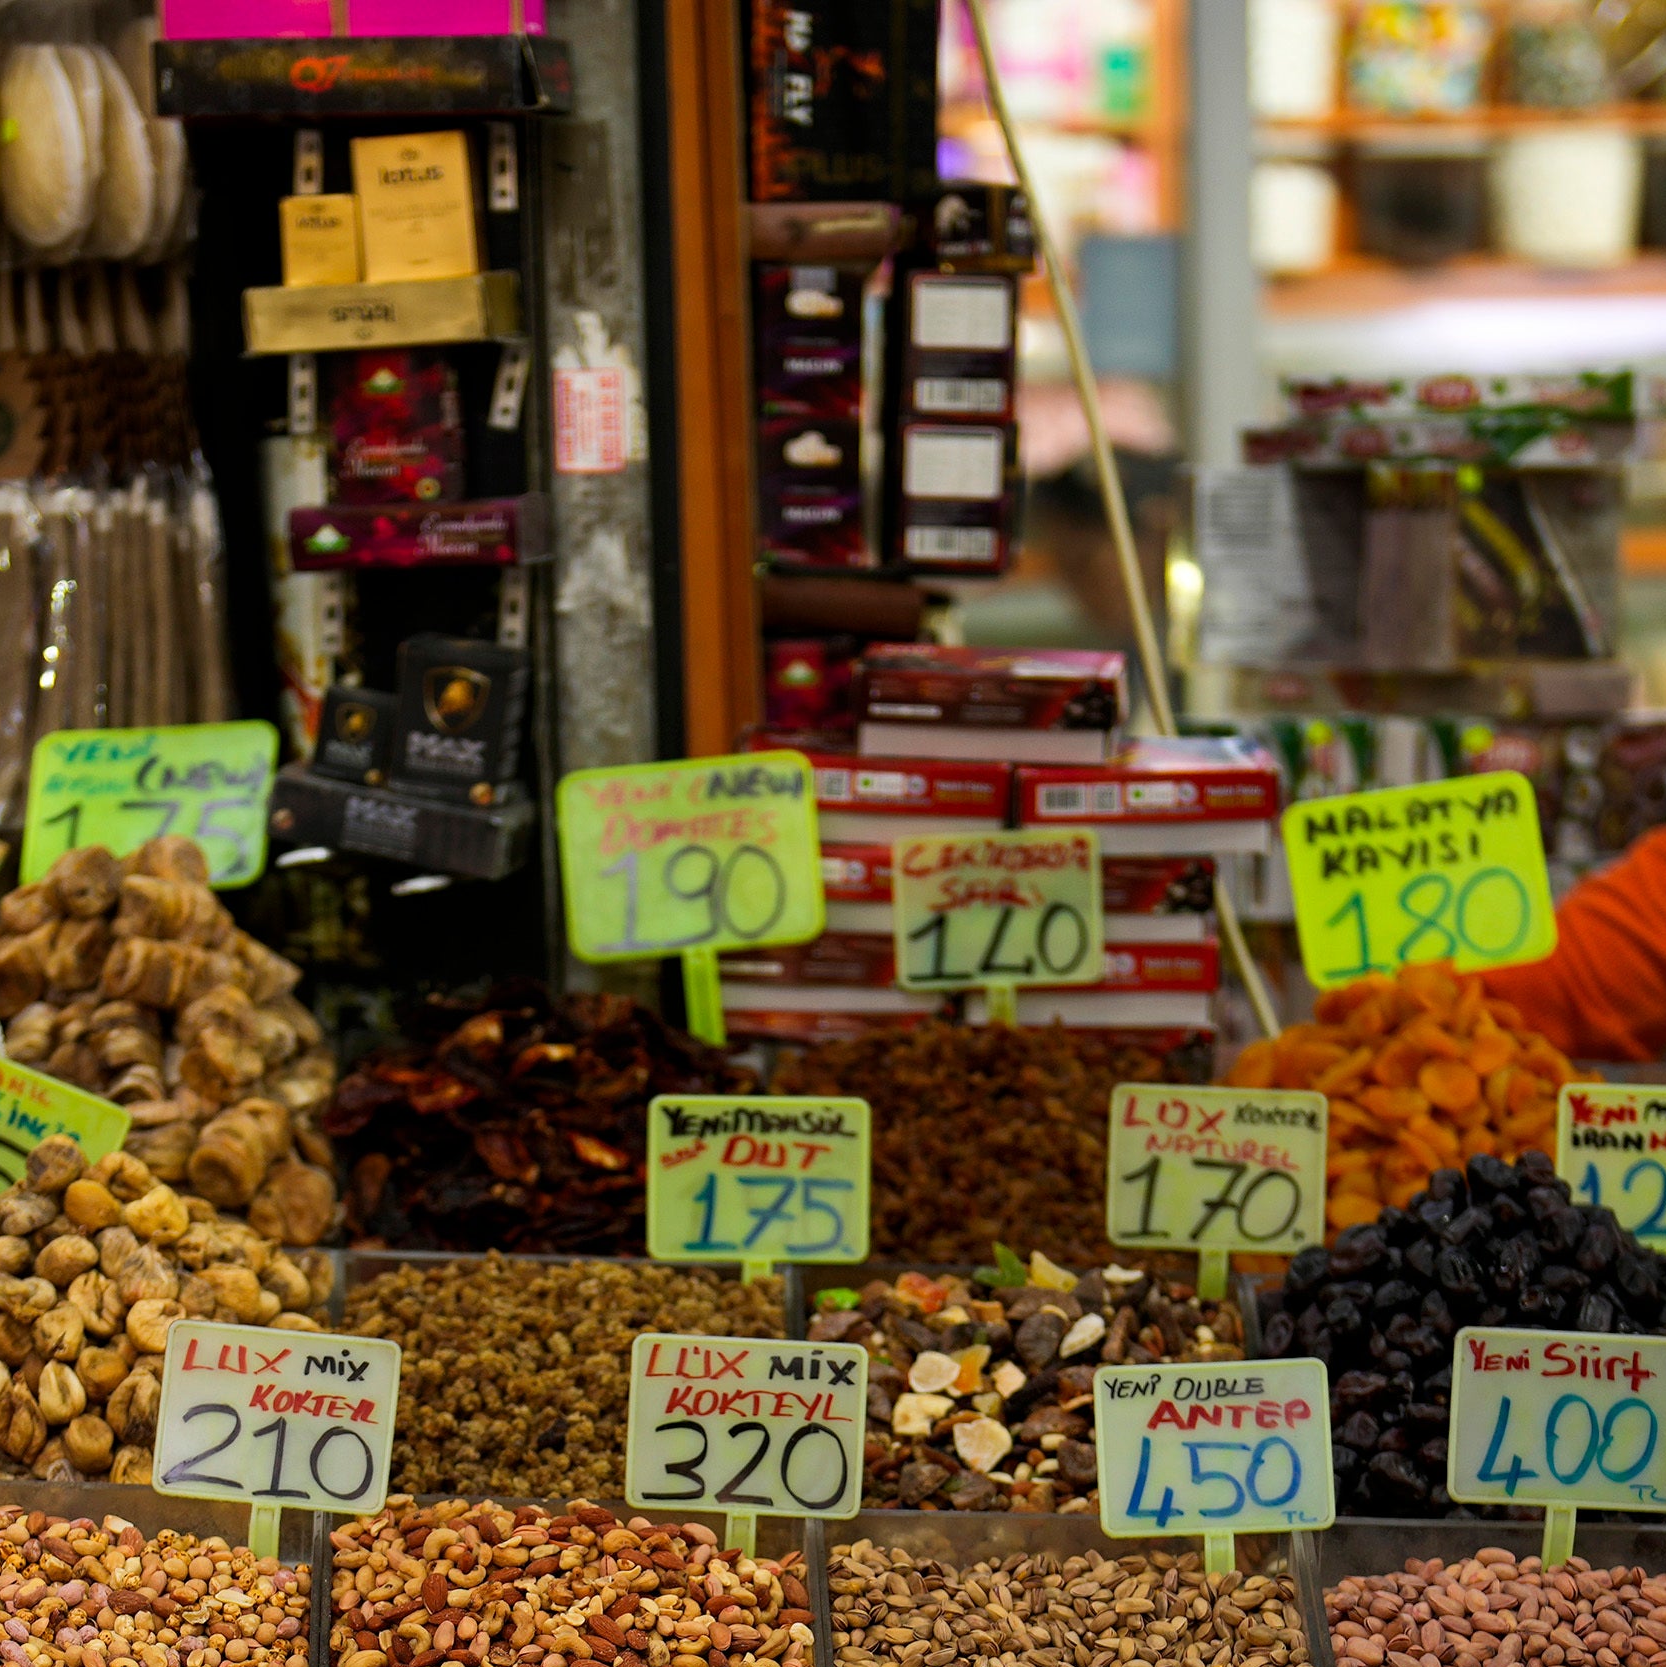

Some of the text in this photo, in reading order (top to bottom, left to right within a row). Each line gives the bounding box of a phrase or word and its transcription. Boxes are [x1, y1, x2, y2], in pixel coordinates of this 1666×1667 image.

[1301, 788, 1520, 847] MALATYA
[1318, 832, 1481, 881] KAYISI
[592, 844, 787, 951] 190
[1323, 865, 1531, 980] 180
[906, 902, 1090, 982] 140
[719, 1134, 833, 1171] DUT
[1144, 1132, 1301, 1171] NATUREL
[682, 1172, 856, 1257] 175
[1116, 1155, 1303, 1242] 170
[665, 1385, 854, 1422] KOKTEYL
[1146, 1398, 1312, 1432] ANTEP
[1476, 1392, 1660, 1498] 400
[162, 1402, 374, 1501] 210
[641, 1420, 848, 1509] 320
[1125, 1436, 1303, 1528] 450
